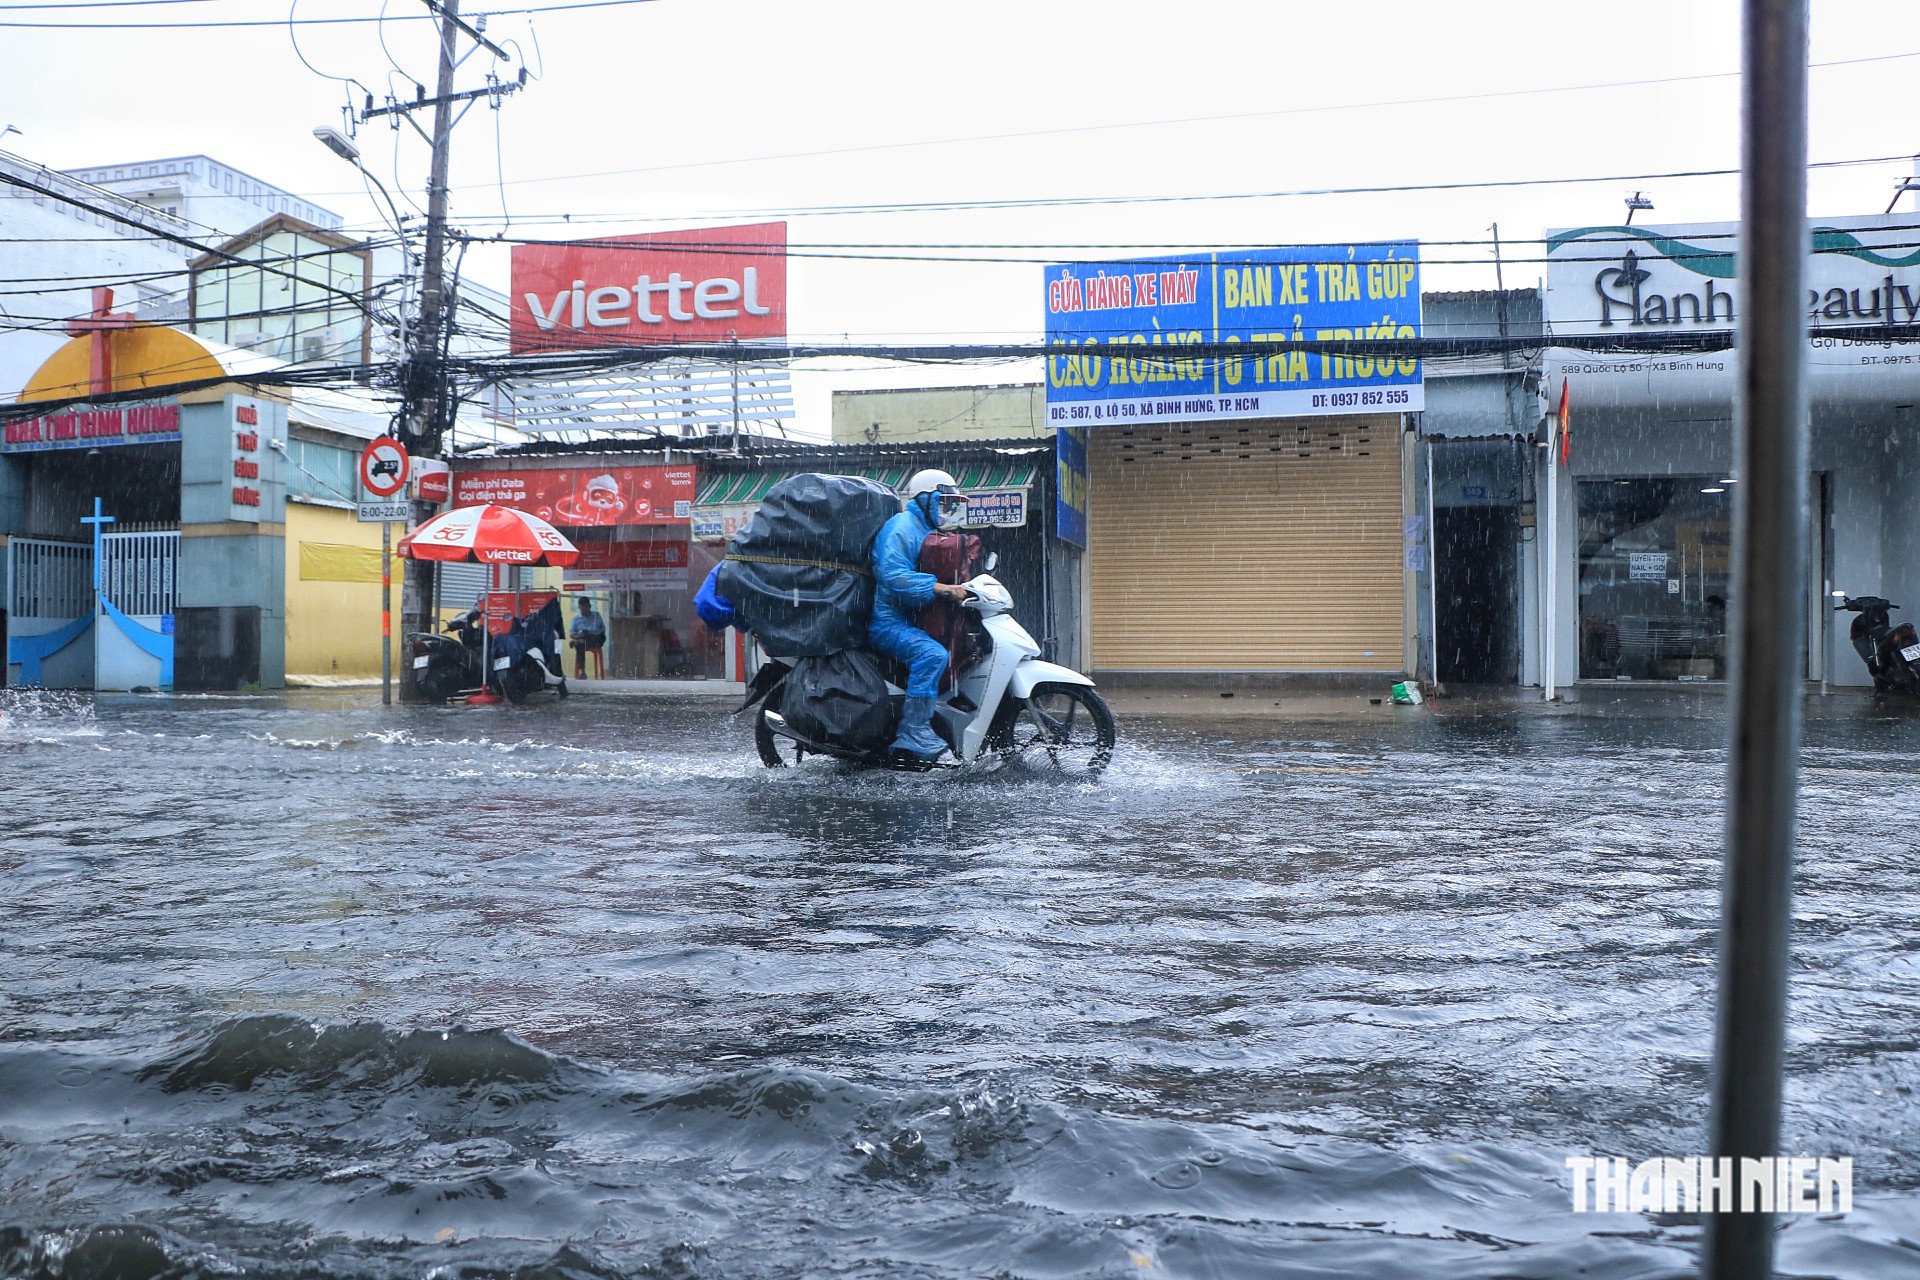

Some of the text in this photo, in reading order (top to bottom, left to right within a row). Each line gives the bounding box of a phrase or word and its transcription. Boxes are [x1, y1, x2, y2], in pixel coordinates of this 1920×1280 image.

[1279, 263, 1309, 305] XE
[1315, 246, 1360, 303] TRẢ
[1367, 250, 1415, 300] GÓP
[524, 266, 771, 331] viettel
[1049, 264, 1198, 313] CỬA HÀNG XE MÁY
[1049, 316, 1203, 388] CAO HOÀNG
[1251, 314, 1309, 384] TRẢ
[1316, 315, 1416, 380] TRƯỚC
[1561, 365, 1580, 374] 589
[1583, 363, 1610, 374] Quốc
[1629, 364, 1642, 372] 50
[1652, 363, 1666, 372] Xã
[1669, 361, 1693, 371] Bình
[1696, 362, 1724, 372] Hưng
[1070, 406, 1092, 420] 587,
[1094, 405, 1104, 419] Q.
[1106, 403, 1119, 419] LỘ
[1121, 404, 1138, 418] 50,
[1140, 401, 1154, 416] XÃ
[1156, 400, 1182, 415] BÌNH
[1218, 399, 1232, 412] TP.
[1235, 398, 1259, 411] HCM
[1331, 393, 1359, 407] 0937
[1361, 391, 1383, 405] 852
[1386, 390, 1409, 404] 555
[237, 404, 258, 425] NHÀ
[237, 430, 258, 452] THỜ
[234, 456, 259, 479] BÌNH
[664, 471, 692, 479] viettel
[501, 478, 525, 488] Data
[232, 486, 260, 507] HƯNG
[513, 491, 527, 501] ga
[1010, 496, 1021, 506] 50
[361, 506, 407, 517] 6:00-22:00
[433, 527, 469, 541] 5G
[485, 549, 532, 561] viettel
